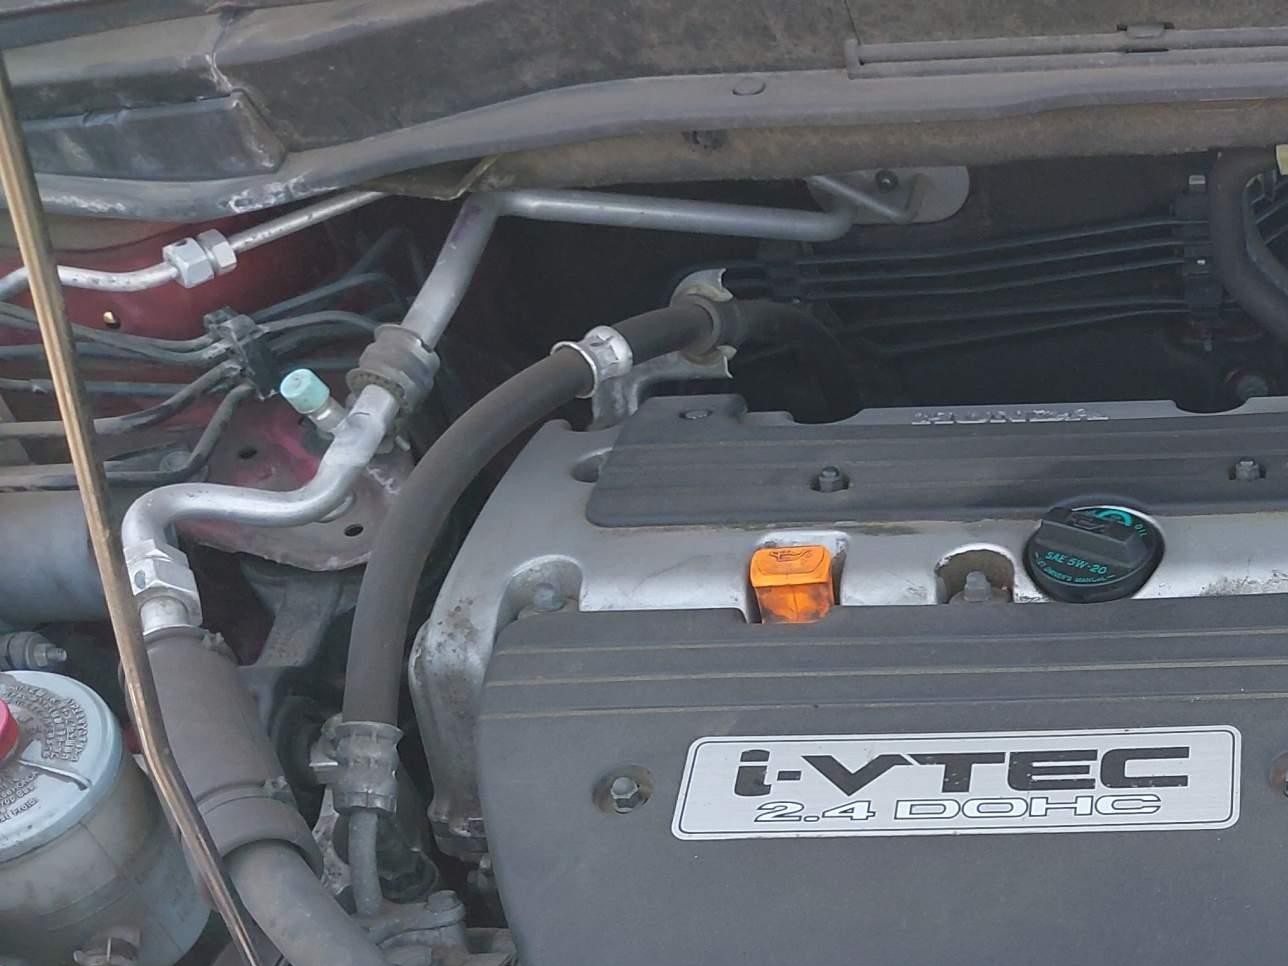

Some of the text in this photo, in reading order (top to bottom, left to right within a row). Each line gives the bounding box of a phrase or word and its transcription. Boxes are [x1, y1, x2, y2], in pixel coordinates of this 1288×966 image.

[1045, 551, 1066, 564] SAE
[1066, 557, 1108, 575] 5W-20
[733, 746, 1192, 798] i-VTEC
[753, 793, 1161, 823] 2.4 DOHC
